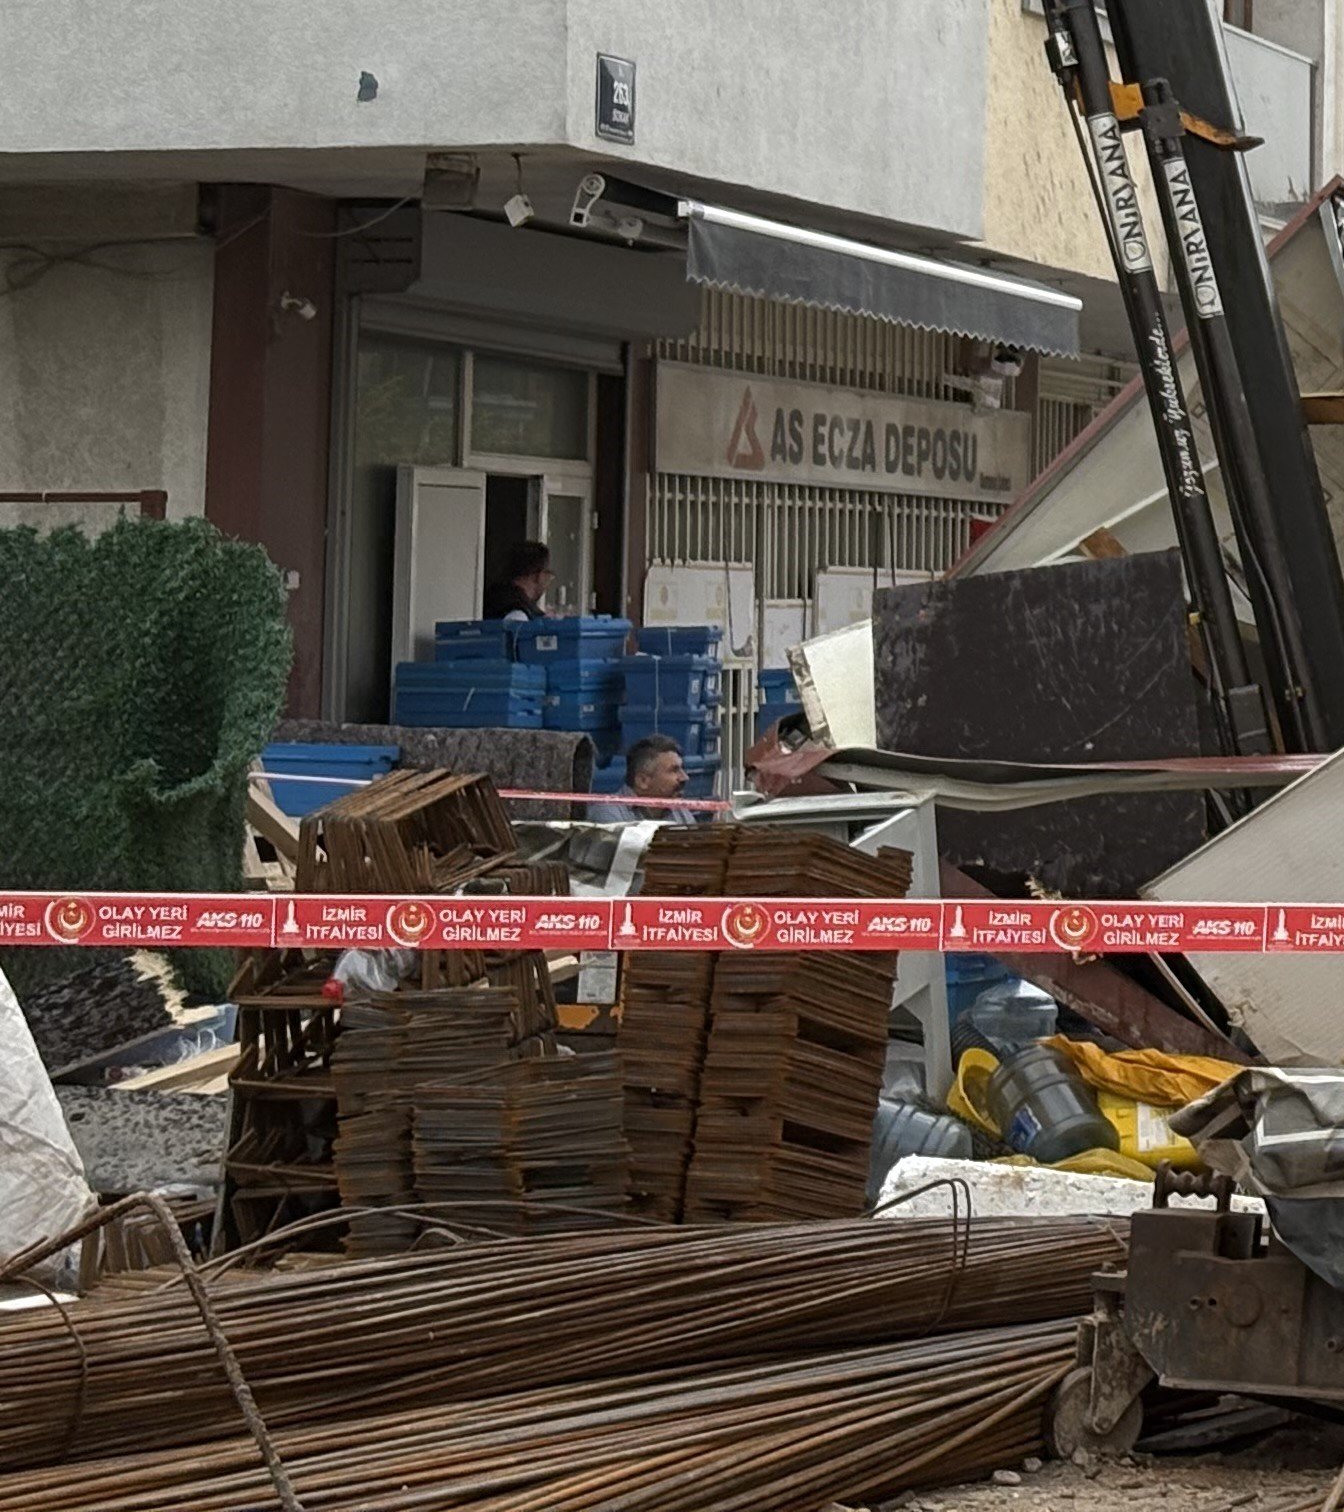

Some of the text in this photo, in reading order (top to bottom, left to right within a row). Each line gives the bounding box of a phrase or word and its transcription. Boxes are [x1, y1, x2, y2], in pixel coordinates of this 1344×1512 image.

[770, 408, 978, 482] AS ECZA DEPOSU
[0, 904, 24, 918] MİR
[99, 904, 188, 919] OLAY YERİ
[322, 906, 366, 921] İZMİR
[439, 908, 526, 923] OLAY YERİ
[658, 908, 703, 924] İZMİR
[774, 909, 859, 925] OLAY YERİ
[988, 911, 1031, 926] İZMİR
[196, 912, 263, 928] AKS 110
[534, 915, 600, 930] AKS 110
[867, 917, 931, 931] AKS 110
[1101, 913, 1184, 928] OLAY YERİ
[1192, 920, 1255, 935] AKS 110
[0, 922, 41, 936] İYESİ
[102, 923, 182, 939] GİRİLMEZ
[306, 924, 382, 940] İTFAİYESİ
[443, 926, 521, 941] GİRİLMEZ
[642, 926, 718, 942] İTFAİYESİ
[777, 928, 854, 943] GİRİLMEZ
[973, 928, 1046, 944] İTFAİYESİ
[1104, 931, 1180, 946] GİRİLMEZ
